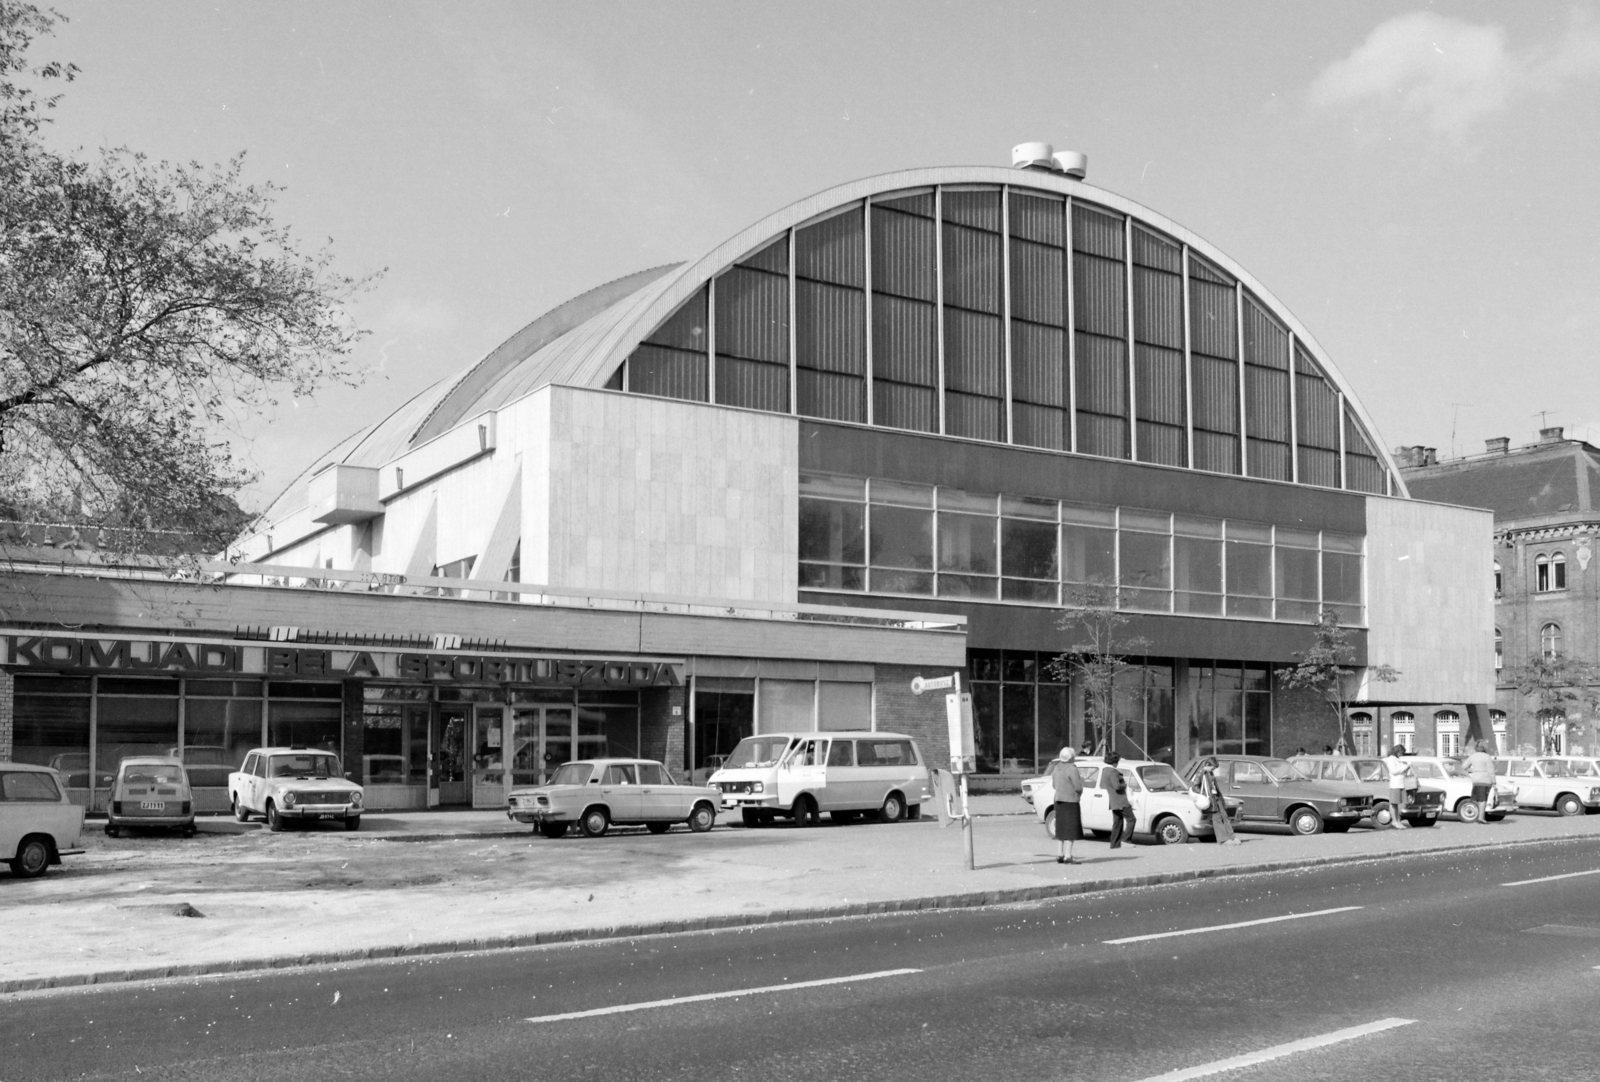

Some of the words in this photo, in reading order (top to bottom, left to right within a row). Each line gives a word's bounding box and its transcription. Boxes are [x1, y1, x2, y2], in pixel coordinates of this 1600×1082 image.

[7, 635, 243, 673] KOMJADI
[266, 647, 380, 677] BELA
[398, 653, 680, 685] SPORTUSZODA
[925, 679, 949, 688] AUTOBUSZ
